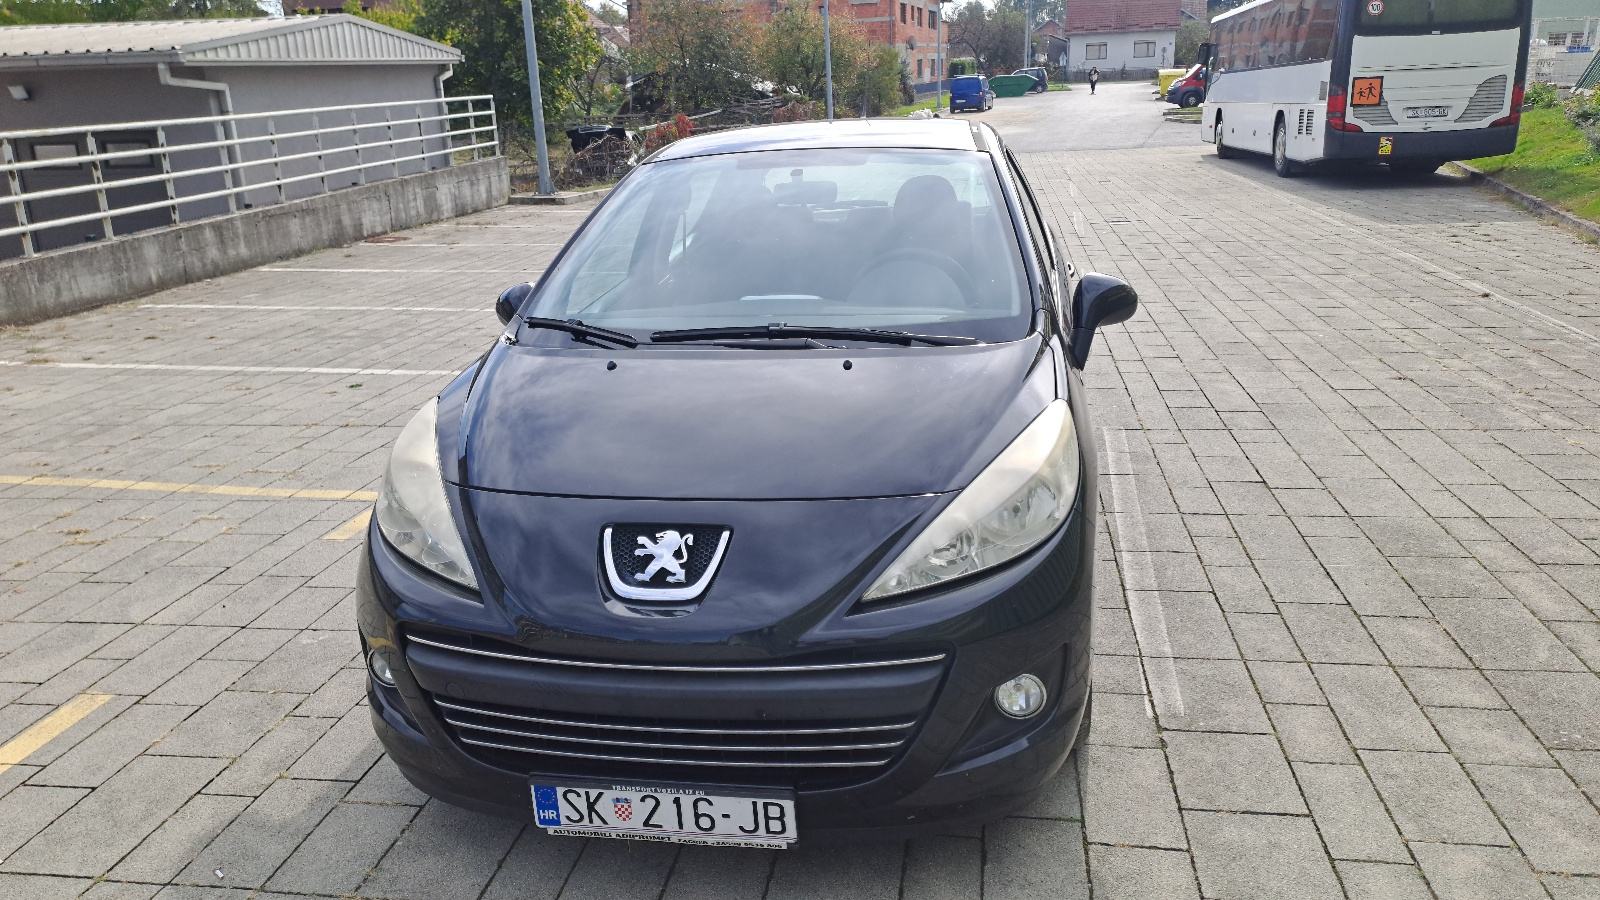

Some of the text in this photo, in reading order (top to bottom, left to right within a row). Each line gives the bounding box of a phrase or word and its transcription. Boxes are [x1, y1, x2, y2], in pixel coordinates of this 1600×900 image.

[613, 785, 654, 793] TRANSPORT
[656, 787, 684, 795] VOZILA
[540, 810, 558, 820] HR
[562, 789, 787, 835] SK 216-JB
[553, 829, 612, 837] AUTOMOBILI
